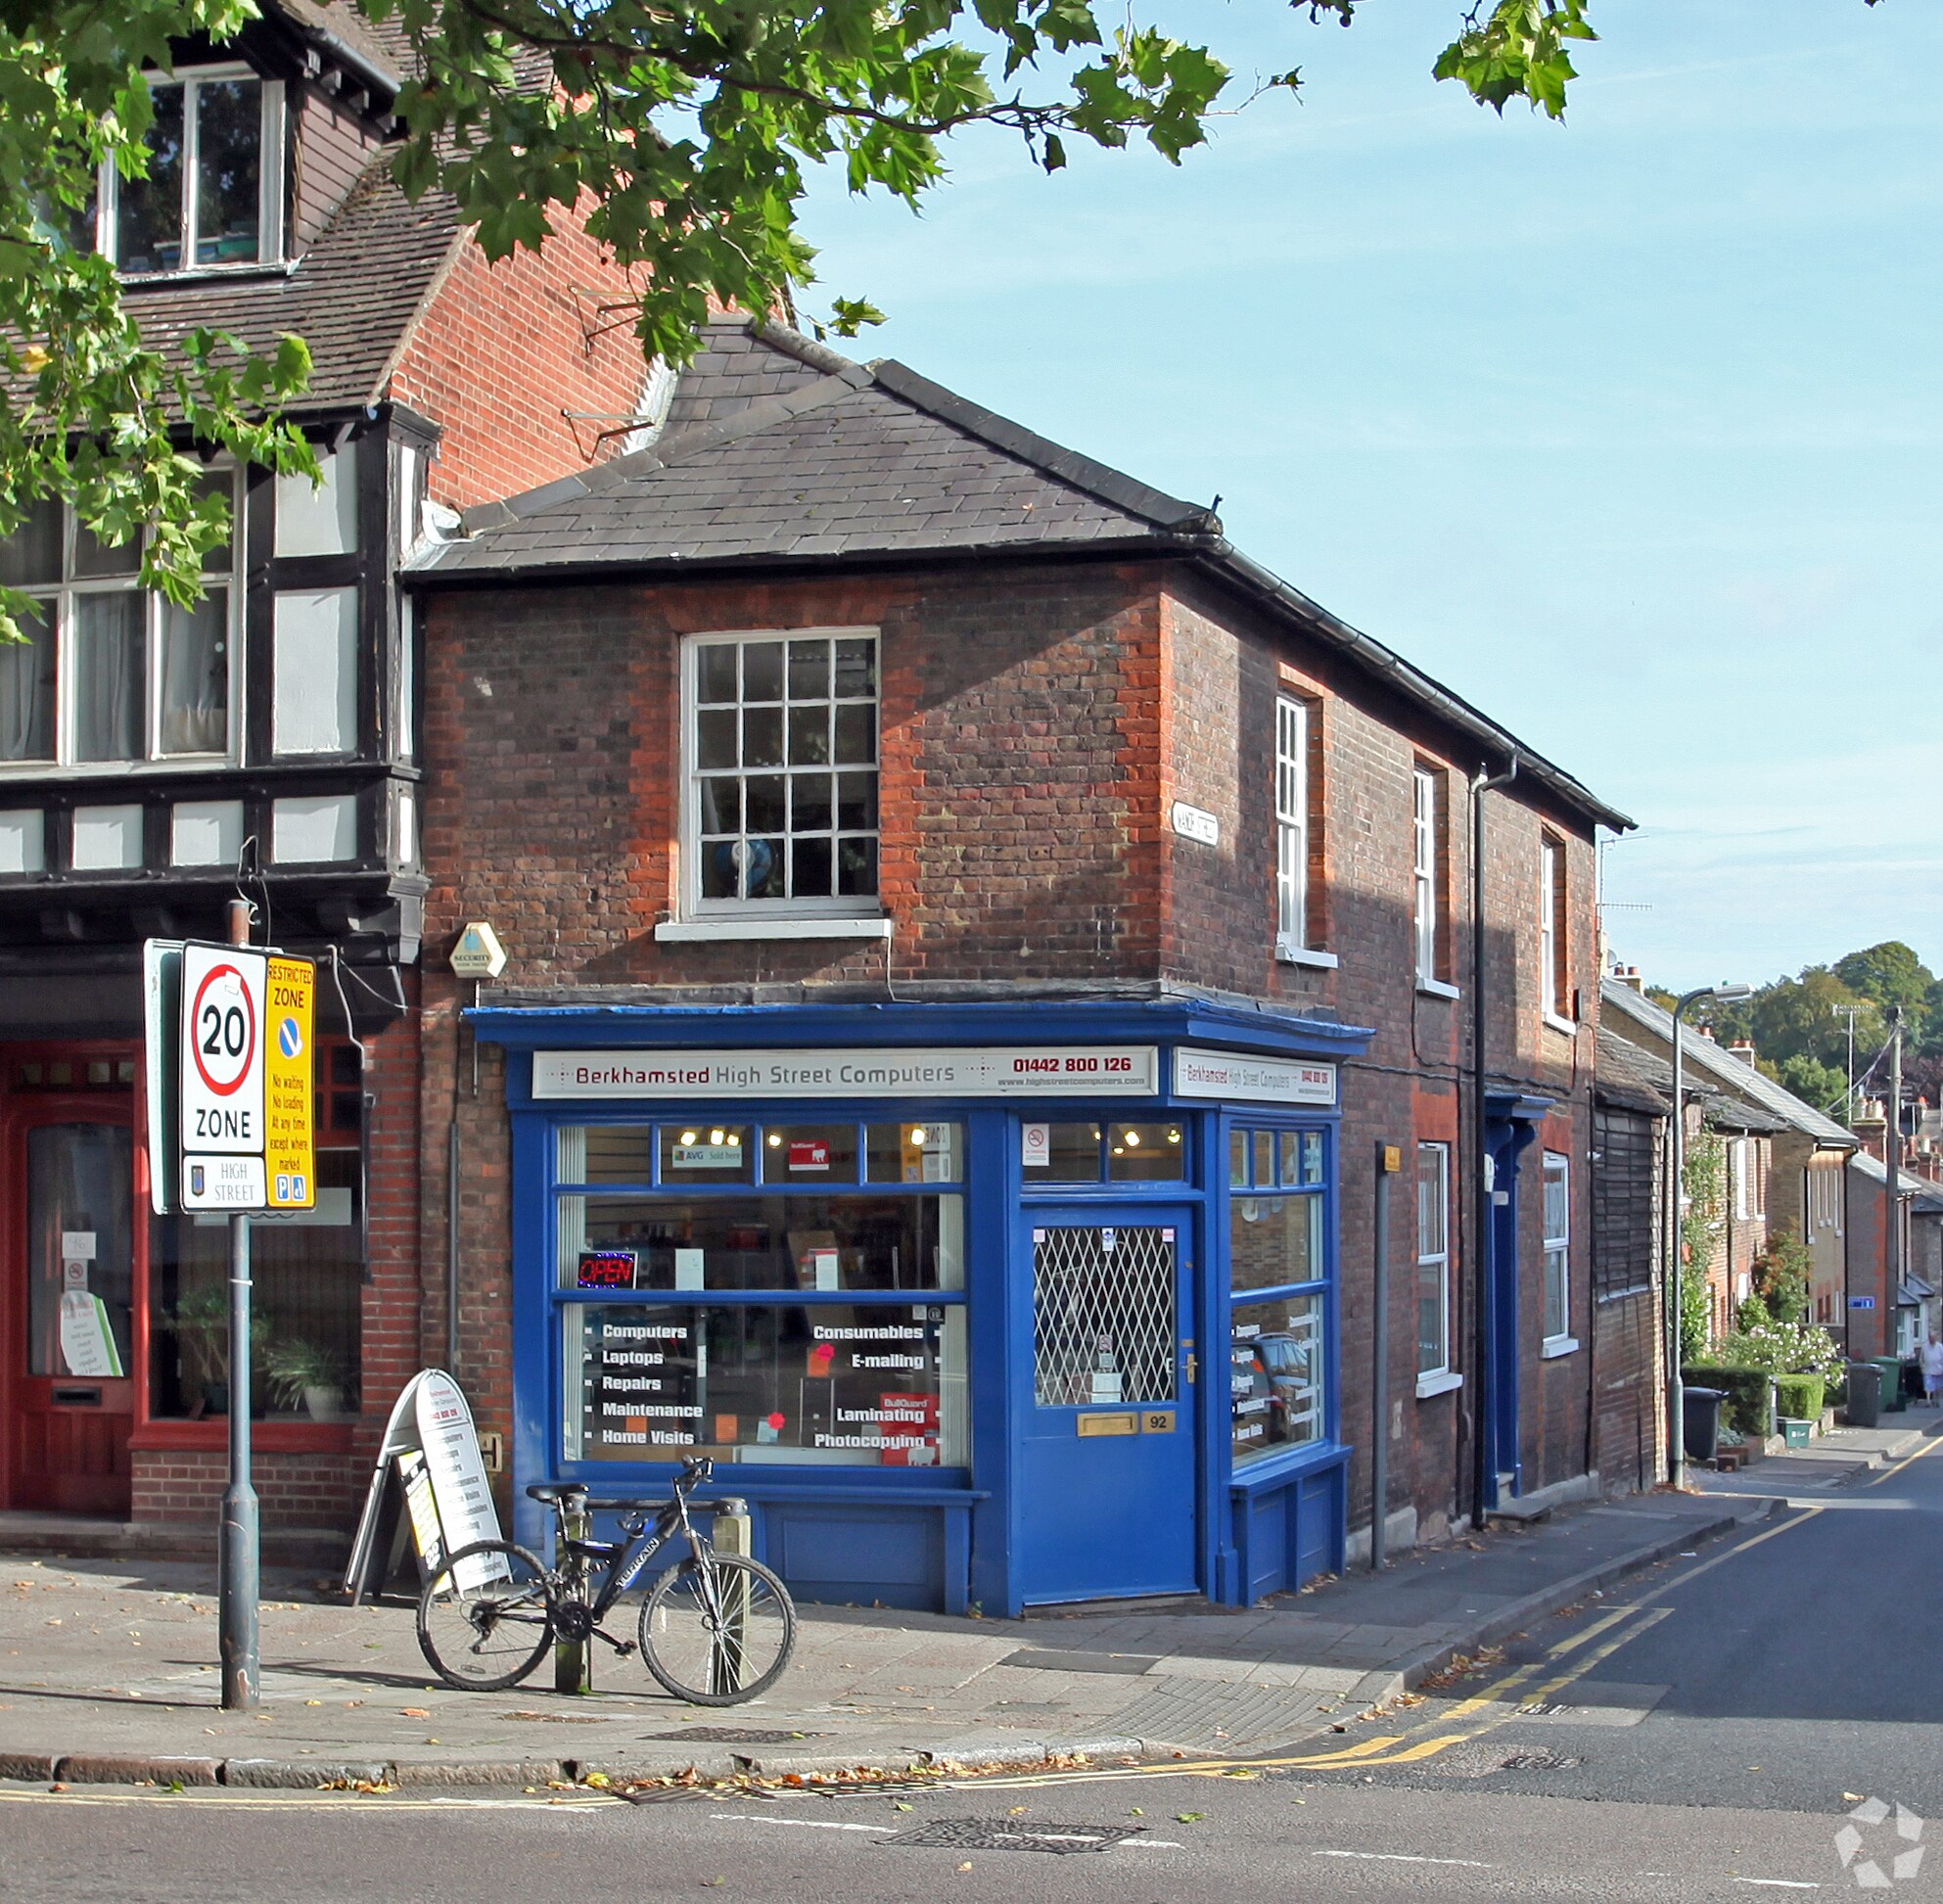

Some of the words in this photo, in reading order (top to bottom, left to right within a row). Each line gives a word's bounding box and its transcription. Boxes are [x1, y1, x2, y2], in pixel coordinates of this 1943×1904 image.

[268, 964, 312, 985] RESTRICTED
[274, 987, 304, 1008] ZONE
[203, 1004, 245, 1057] 20
[1013, 1058, 1059, 1073] 01442
[1065, 1058, 1098, 1072] 800
[1104, 1057, 1132, 1072] 126
[273, 1073, 282, 1089] No
[283, 1074, 303, 1092] waiting
[577, 1067, 710, 1084] Berkhamsted
[717, 1066, 761, 1087] High
[770, 1065, 832, 1084] Street
[840, 1065, 955, 1086] Computers
[997, 1078, 1145, 1087] www.highstreetcomputers.com
[273, 1093, 282, 1109] No
[283, 1094, 303, 1113] loading
[196, 1108, 251, 1138] ZONE
[272, 1115, 279, 1129] At
[281, 1119, 291, 1133] any
[293, 1116, 305, 1131] time
[270, 1137, 289, 1153] except
[291, 1137, 308, 1151] where
[279, 1156, 301, 1171] marked
[686, 1151, 704, 1160] AVG
[221, 1163, 248, 1180] HIGH
[214, 1184, 254, 1201] STREET
[278, 1179, 288, 1199] P
[579, 1260, 634, 1282] OPEN
[602, 1324, 687, 1339] Computers
[813, 1324, 924, 1340] Consumables
[602, 1350, 664, 1366] Laptops
[852, 1354, 924, 1370] E-mailing
[602, 1375, 662, 1391] Repairs
[602, 1402, 704, 1417] Maintenance
[837, 1407, 925, 1423] Laminating
[1150, 1416, 1167, 1428] 92
[602, 1429, 647, 1444] Home
[651, 1429, 695, 1445] Visits
[814, 1433, 925, 1450] Photocopying
